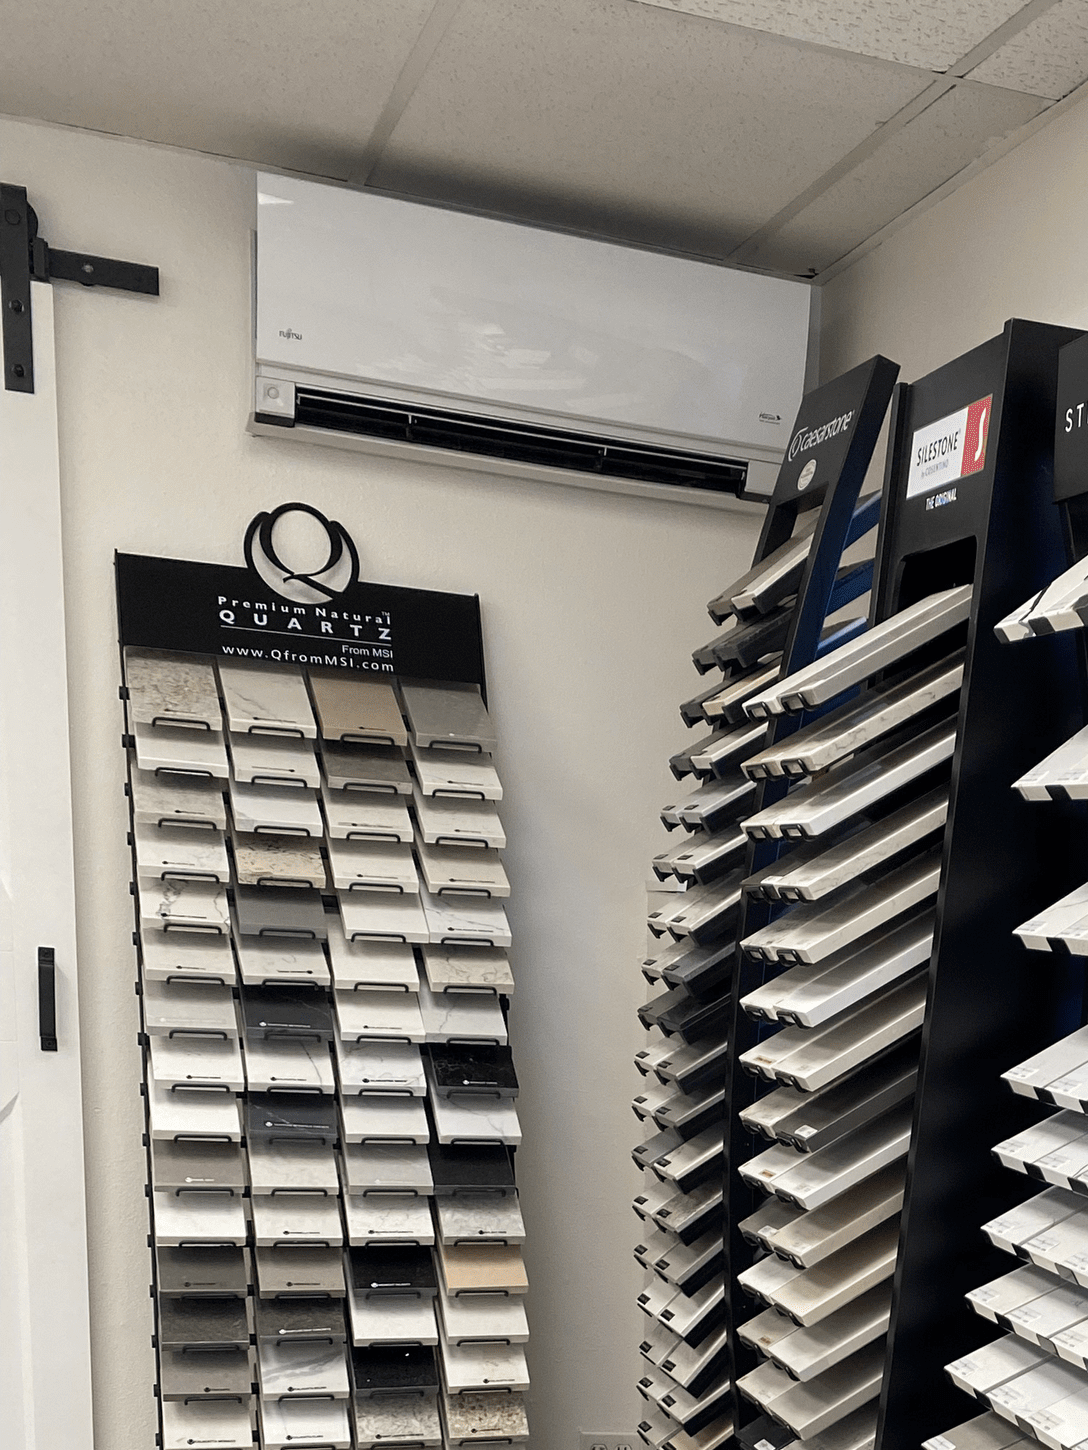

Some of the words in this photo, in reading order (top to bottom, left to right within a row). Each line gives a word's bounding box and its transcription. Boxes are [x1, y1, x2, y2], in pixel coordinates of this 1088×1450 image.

[917, 431, 959, 467] SILESTONE
[218, 595, 306, 616] Premium
[315, 607, 392, 625] Natural
[219, 609, 392, 641] QUARTZ
[222, 645, 395, 673] www.QfromMSI.com
[342, 644, 371, 657] From
[372, 648, 394, 659] MSI
